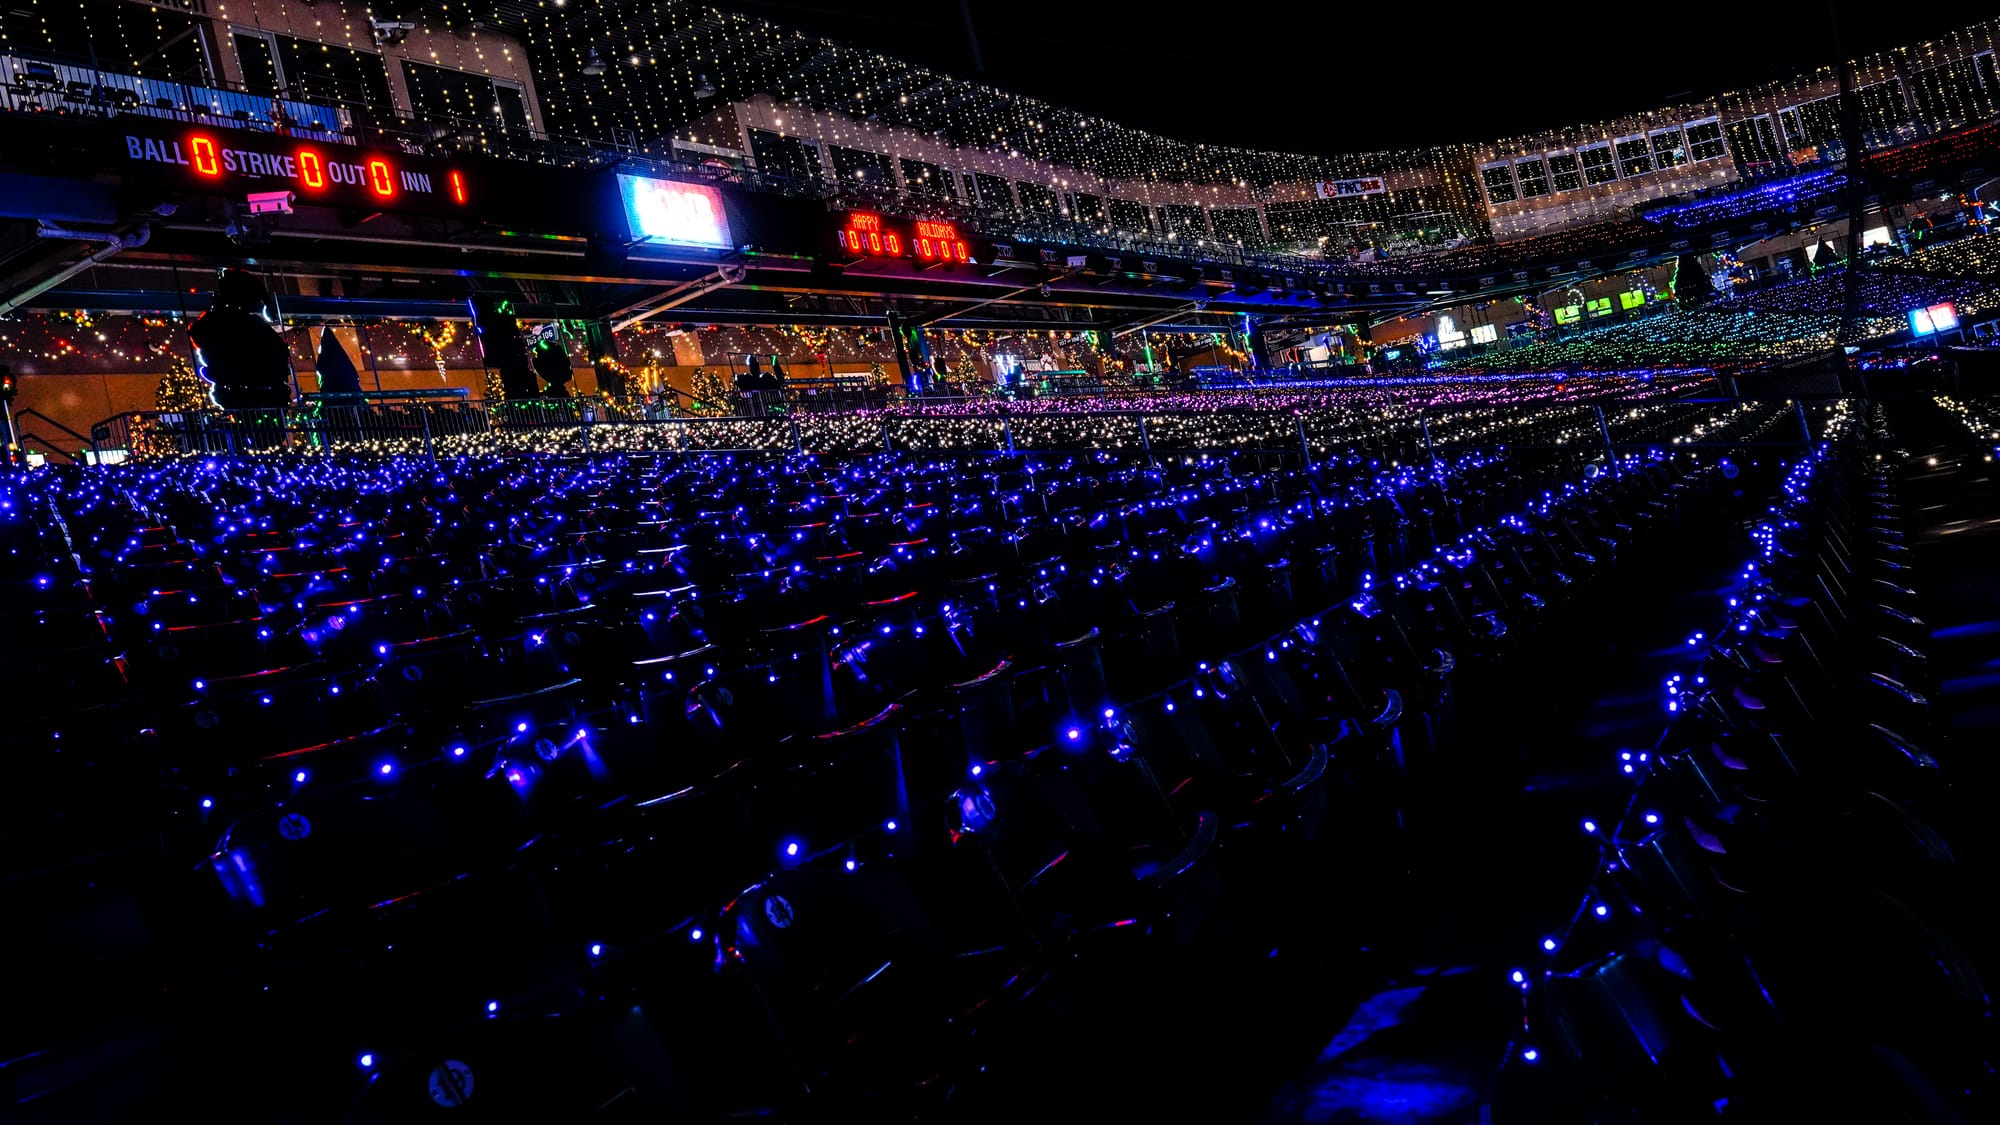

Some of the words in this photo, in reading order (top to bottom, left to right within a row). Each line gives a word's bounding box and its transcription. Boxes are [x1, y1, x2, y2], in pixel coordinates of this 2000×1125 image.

[125, 135, 190, 166] BALL
[192, 137, 218, 175] 0
[224, 149, 299, 179] STRIKE
[300, 152, 323, 188] 0
[329, 162, 366, 187] OUT
[371, 161, 393, 196] 0
[401, 171, 433, 194] INN
[454, 173, 463, 202] 1
[852, 213, 879, 231] HAPPY
[918, 222, 955, 240] HOLIDAYS
[838, 230, 848, 248] R
[861, 233, 870, 249] H
[913, 239, 922, 255] R
